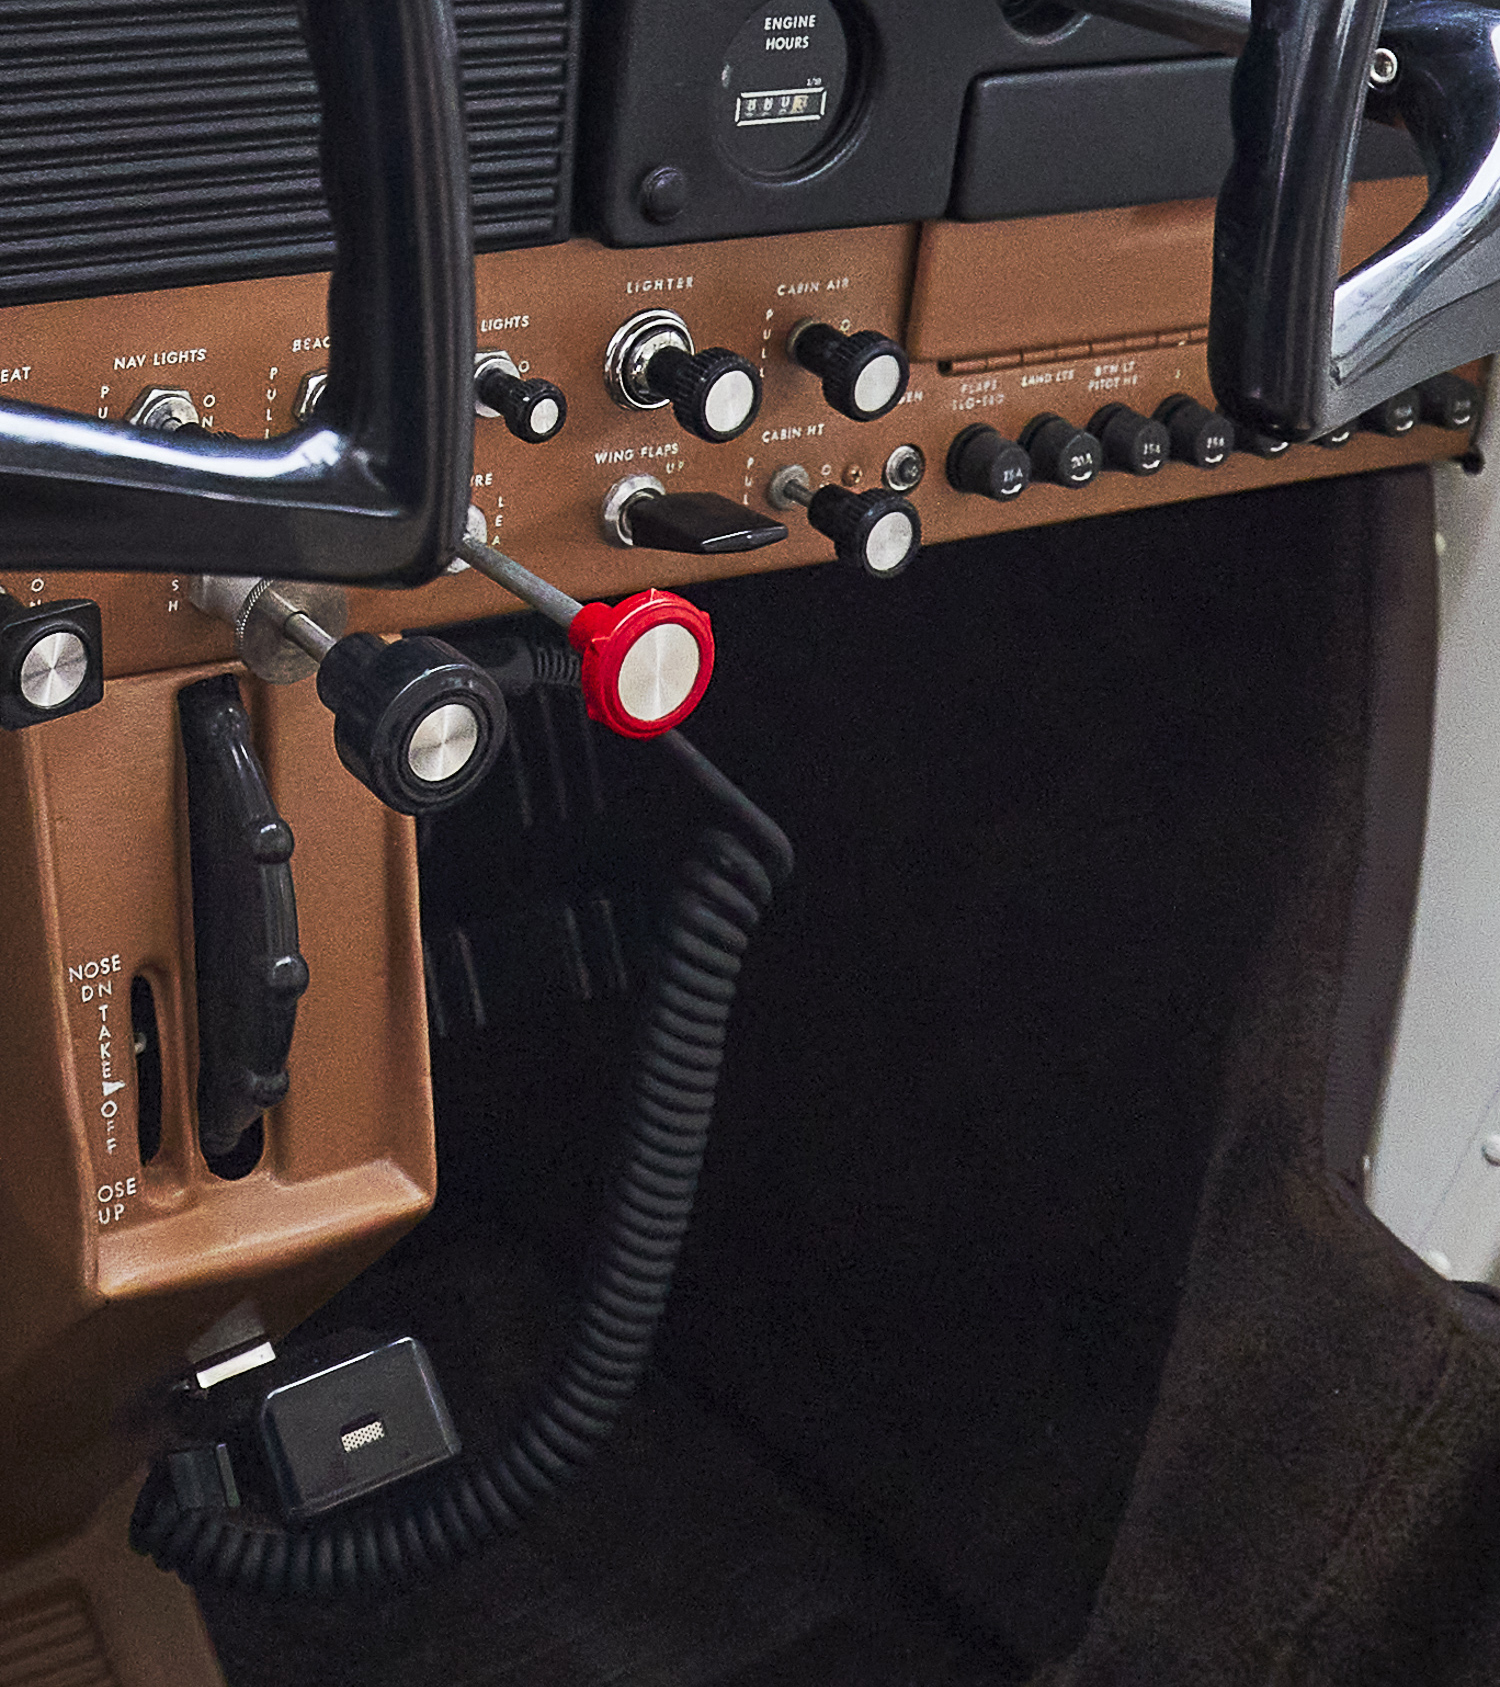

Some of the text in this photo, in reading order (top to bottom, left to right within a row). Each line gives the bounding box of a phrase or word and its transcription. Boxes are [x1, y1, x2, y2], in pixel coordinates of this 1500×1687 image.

[764, 15, 816, 30] ENGINE
[766, 36, 809, 50] HOURS
[626, 276, 693, 294] LIGHTER
[777, 277, 849, 297] CABIN AIR
[481, 315, 530, 332] LIGHTS
[293, 336, 330, 353] BEAC
[114, 349, 207, 370] NAV LIGHTS
[762, 423, 825, 443] CABIN HT
[595, 443, 679, 465] WING FLAPS
[492, 496, 504, 546] LEA
[68, 955, 121, 983] NOSE
[81, 980, 112, 1003] DN
[98, 1004, 112, 1079] TAKE
[98, 1204, 125, 1225] UP
